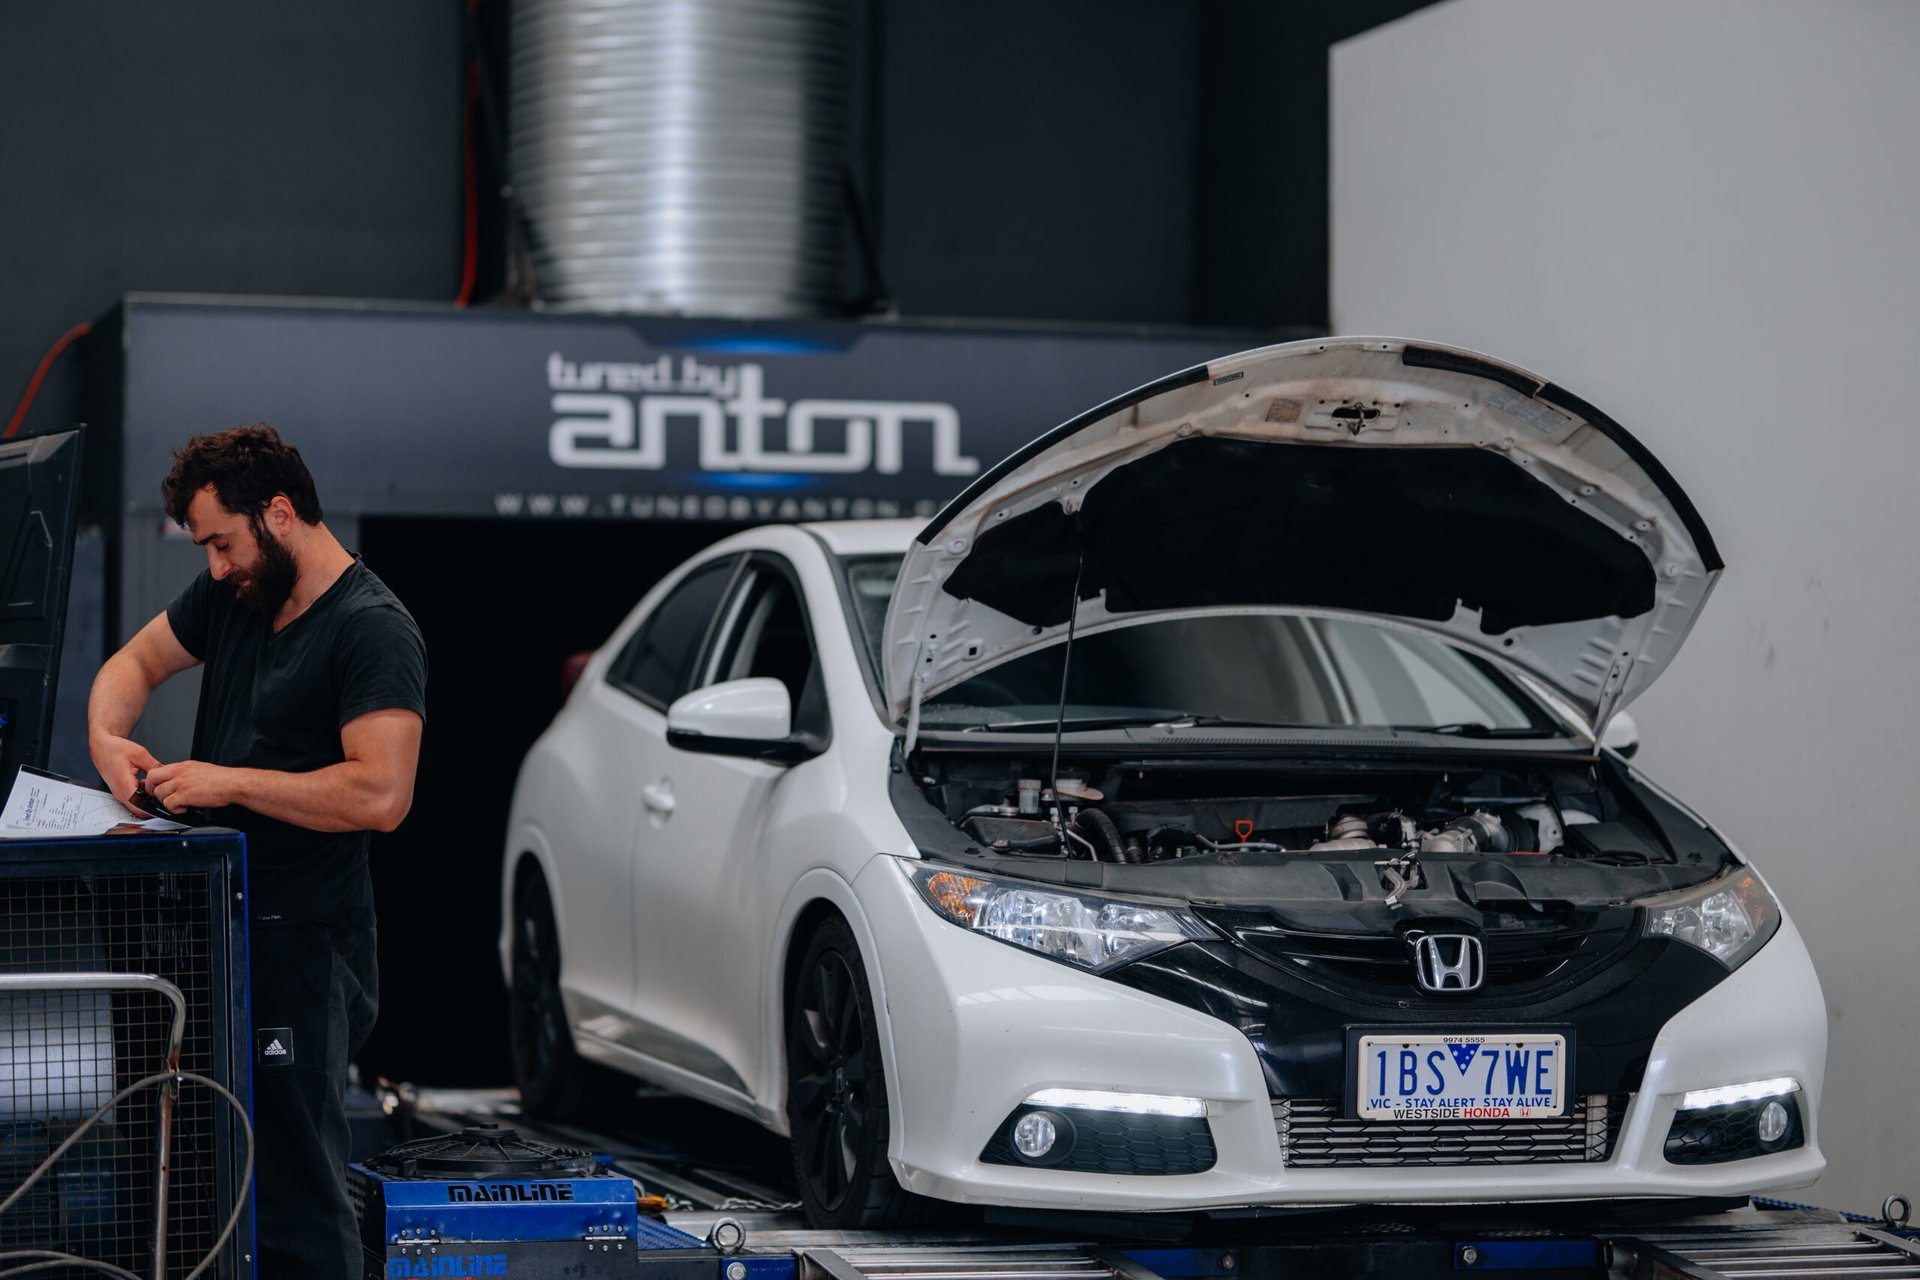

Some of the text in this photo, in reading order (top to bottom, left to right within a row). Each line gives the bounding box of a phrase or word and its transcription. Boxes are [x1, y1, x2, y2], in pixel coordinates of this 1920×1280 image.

[549, 363, 980, 475] anton
[1370, 1098, 1391, 1109] VIC
[1405, 1098, 1436, 1109] STAY
[1438, 1098, 1475, 1108] ALERT
[1483, 1098, 1514, 1108] STAY
[1516, 1097, 1551, 1107] ALIVE
[1393, 1108, 1460, 1119] WESTSIDE
[1463, 1108, 1510, 1118] HONDA
